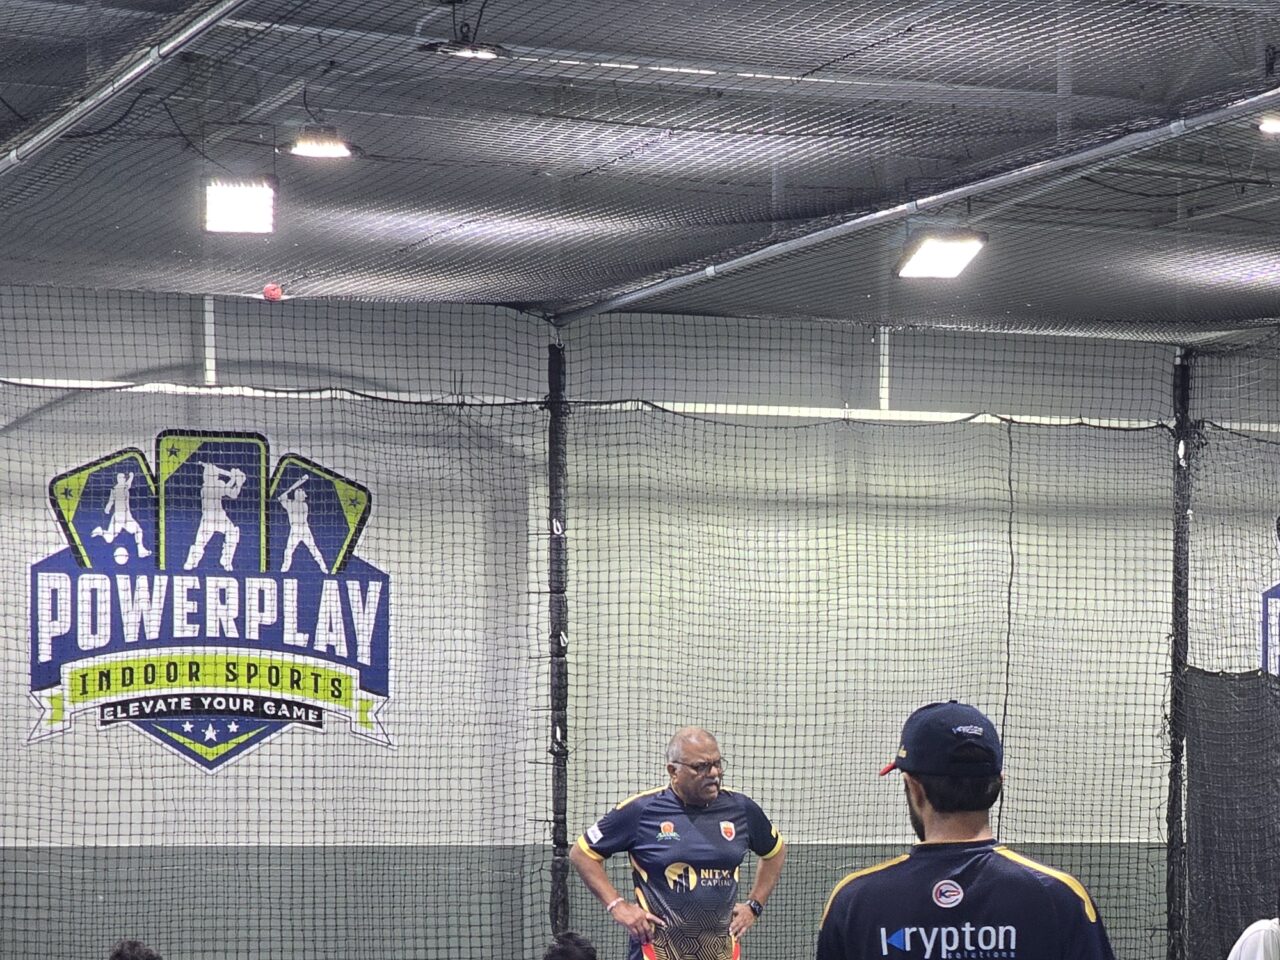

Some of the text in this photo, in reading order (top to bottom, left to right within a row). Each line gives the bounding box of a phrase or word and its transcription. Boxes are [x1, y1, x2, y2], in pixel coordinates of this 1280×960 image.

[37, 572, 382, 666] POWERPLAY
[79, 661, 343, 699] INDOOR SPORTS
[104, 696, 319, 722] ELEVATE YOUR GAME
